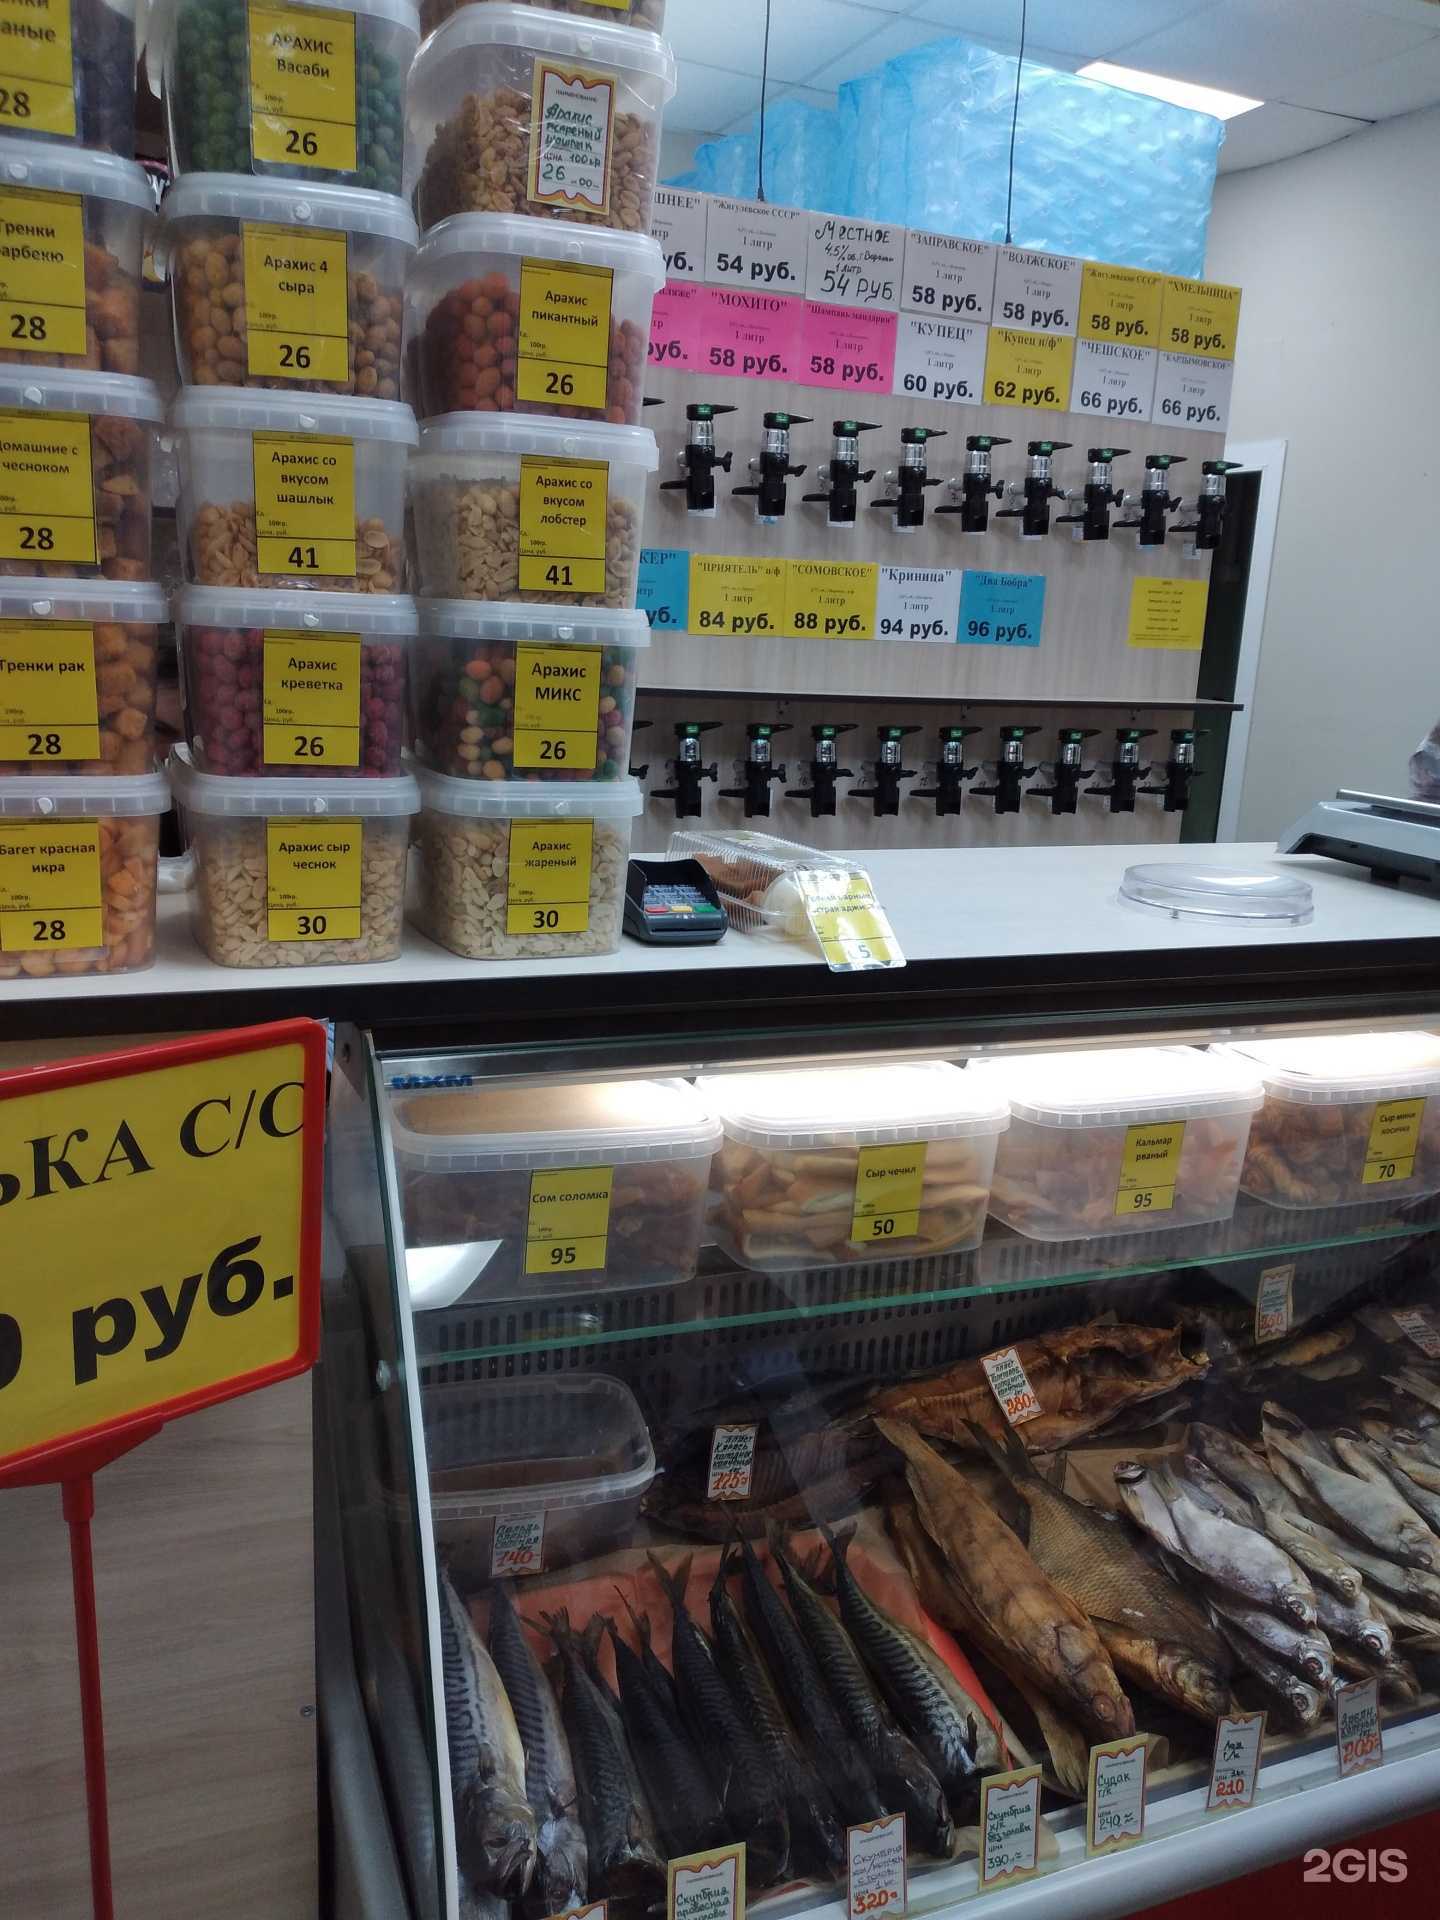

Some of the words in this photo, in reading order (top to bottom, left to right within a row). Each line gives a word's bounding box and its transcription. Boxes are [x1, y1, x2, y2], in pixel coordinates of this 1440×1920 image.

[272, 31, 334, 55] АРАХИС
[277, 58, 330, 78] Васаби
[286, 130, 318, 156] 26
[542, 163, 566, 181] 26
[264, 254, 317, 272] Арахис
[319, 260, 329, 273] 4
[717, 253, 743, 274] 54
[751, 261, 796, 282] руб.
[278, 281, 315, 296] сыра
[820, 270, 850, 296] 54
[544, 290, 588, 306] Арахис
[712, 291, 787, 312] "МОХИТО"
[912, 285, 935, 305] 58
[942, 293, 982, 313] руб.
[532, 310, 598, 327] пикантный
[1002, 302, 1025, 320] 58
[1031, 309, 1070, 328] руб.
[10, 313, 47, 341] 28
[911, 321, 973, 343] "КУПЕЦ"
[1091, 314, 1110, 330] 58
[1115, 320, 1149, 337] руб.
[1171, 327, 1189, 344] 58
[1194, 334, 1226, 351] руб.
[279, 344, 311, 369] 26
[709, 347, 735, 367] 58
[743, 355, 787, 374] руб.
[810, 355, 835, 375] 58
[842, 363, 884, 383] руб.
[545, 372, 574, 396] 26
[903, 373, 927, 392] 60
[933, 380, 973, 399] руб.
[994, 380, 1016, 398] 62
[1022, 387, 1060, 405] руб.
[1080, 390, 1102, 408] 66
[1107, 397, 1143, 415] руб.
[1162, 398, 1182, 416] 66
[1186, 405, 1221, 423] руб.
[71, 446, 78, 455] с
[271, 451, 319, 466] Арахис
[322, 457, 337, 466] со
[2, 461, 70, 474] чесноком
[281, 474, 329, 486] вкусом
[535, 475, 577, 489] Арахис
[580, 480, 593, 489] со
[277, 493, 336, 505] шашлык
[543, 496, 585, 508] вкусом
[540, 513, 587, 527] лобстер
[19, 526, 55, 550] 28
[288, 546, 319, 569] 41
[545, 565, 573, 586] 41
[792, 564, 872, 578] "СОМОВСКОЕ"
[882, 568, 952, 584] "Криница"
[699, 611, 725, 628] 84
[732, 613, 774, 633] руб.
[794, 612, 818, 629] 88
[825, 615, 866, 634] руб.
[880, 619, 903, 635] 94
[910, 620, 948, 640] руб.
[968, 620, 991, 637] 96
[995, 623, 1032, 642] руб.
[59, 661, 86, 675] рак
[288, 657, 337, 671] Арахис
[531, 662, 587, 679] Арахис
[281, 679, 344, 691] креветка
[535, 687, 582, 701] МИКС
[28, 733, 62, 755] 28
[294, 735, 325, 757] 26
[540, 740, 566, 760] 26
[40, 844, 96, 856] красная
[279, 842, 324, 854] Арахис
[327, 843, 350, 854] сыр
[532, 841, 571, 851] Арахис
[32, 863, 66, 875] икра
[293, 860, 336, 870] чеснок
[525, 856, 577, 868] жареный
[297, 915, 327, 935] 30
[533, 910, 559, 928] 30
[33, 919, 66, 941] 28
[180, 1081, 305, 1157] С/С
[1136, 1137, 1173, 1147] Кальмар
[1136, 1150, 1168, 1162] рваный
[865, 1168, 886, 1179] Сыр
[1379, 1163, 1396, 1179] 70
[532, 1193, 556, 1204] Сом
[559, 1191, 609, 1202] соломка
[1133, 1193, 1152, 1208] 95
[872, 1218, 894, 1236] 50
[551, 1247, 576, 1265] 95
[72, 1235, 294, 1386] руб.
[1097, 1772, 1131, 1787] Судак
[987, 1854, 1009, 1869] 390
